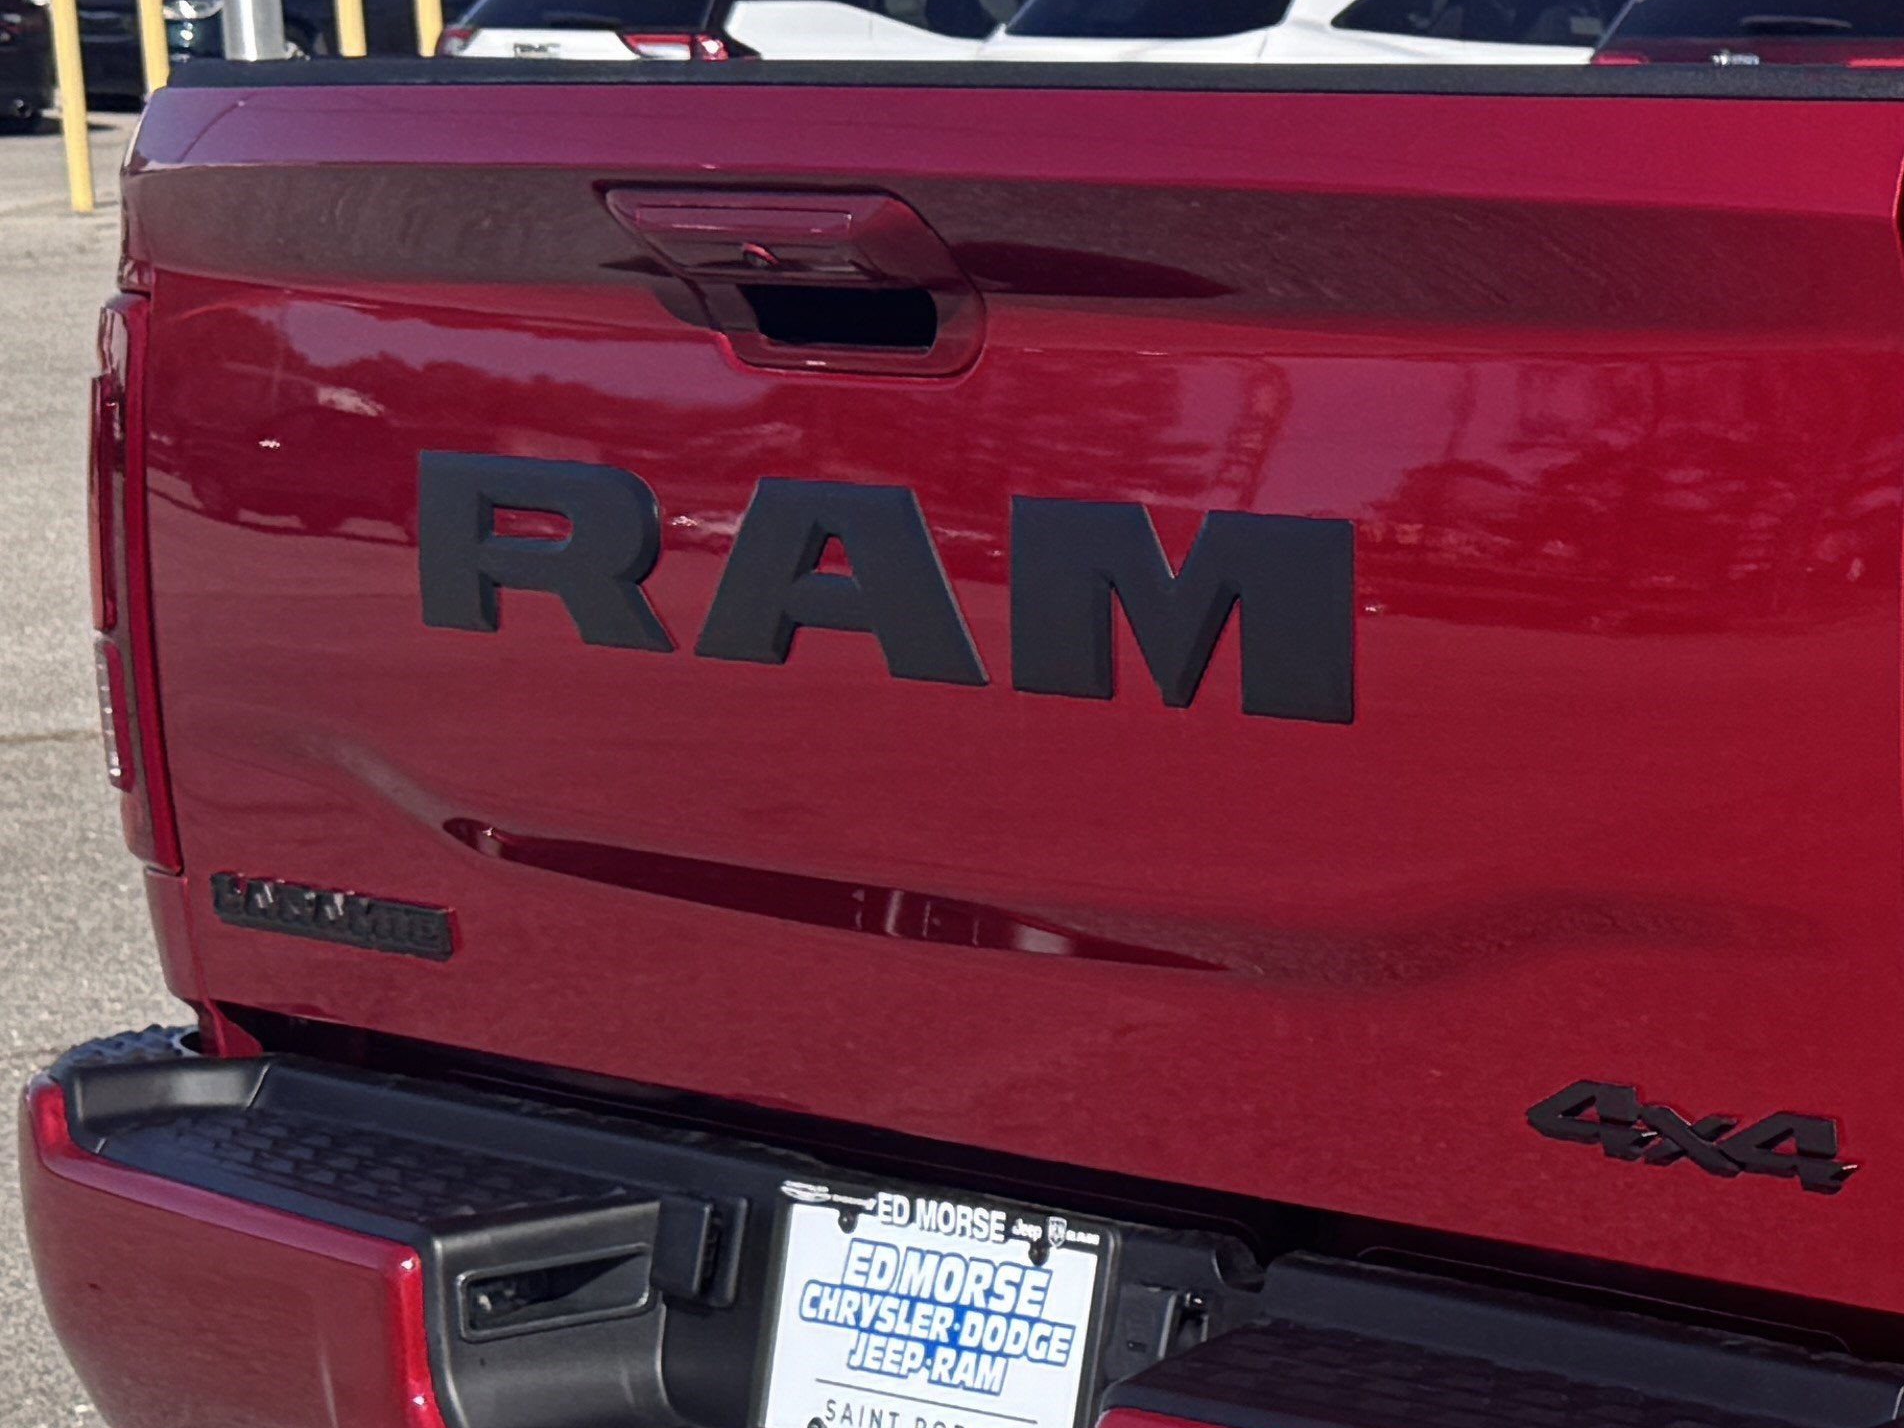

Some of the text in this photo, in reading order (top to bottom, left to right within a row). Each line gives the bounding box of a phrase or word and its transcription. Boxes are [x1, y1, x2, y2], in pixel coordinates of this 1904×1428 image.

[419, 449, 1355, 724] RAM
[876, 1191, 911, 1225] ED
[916, 1198, 1007, 1243] MORSE
[842, 1238, 1053, 1320] ED MORSE
